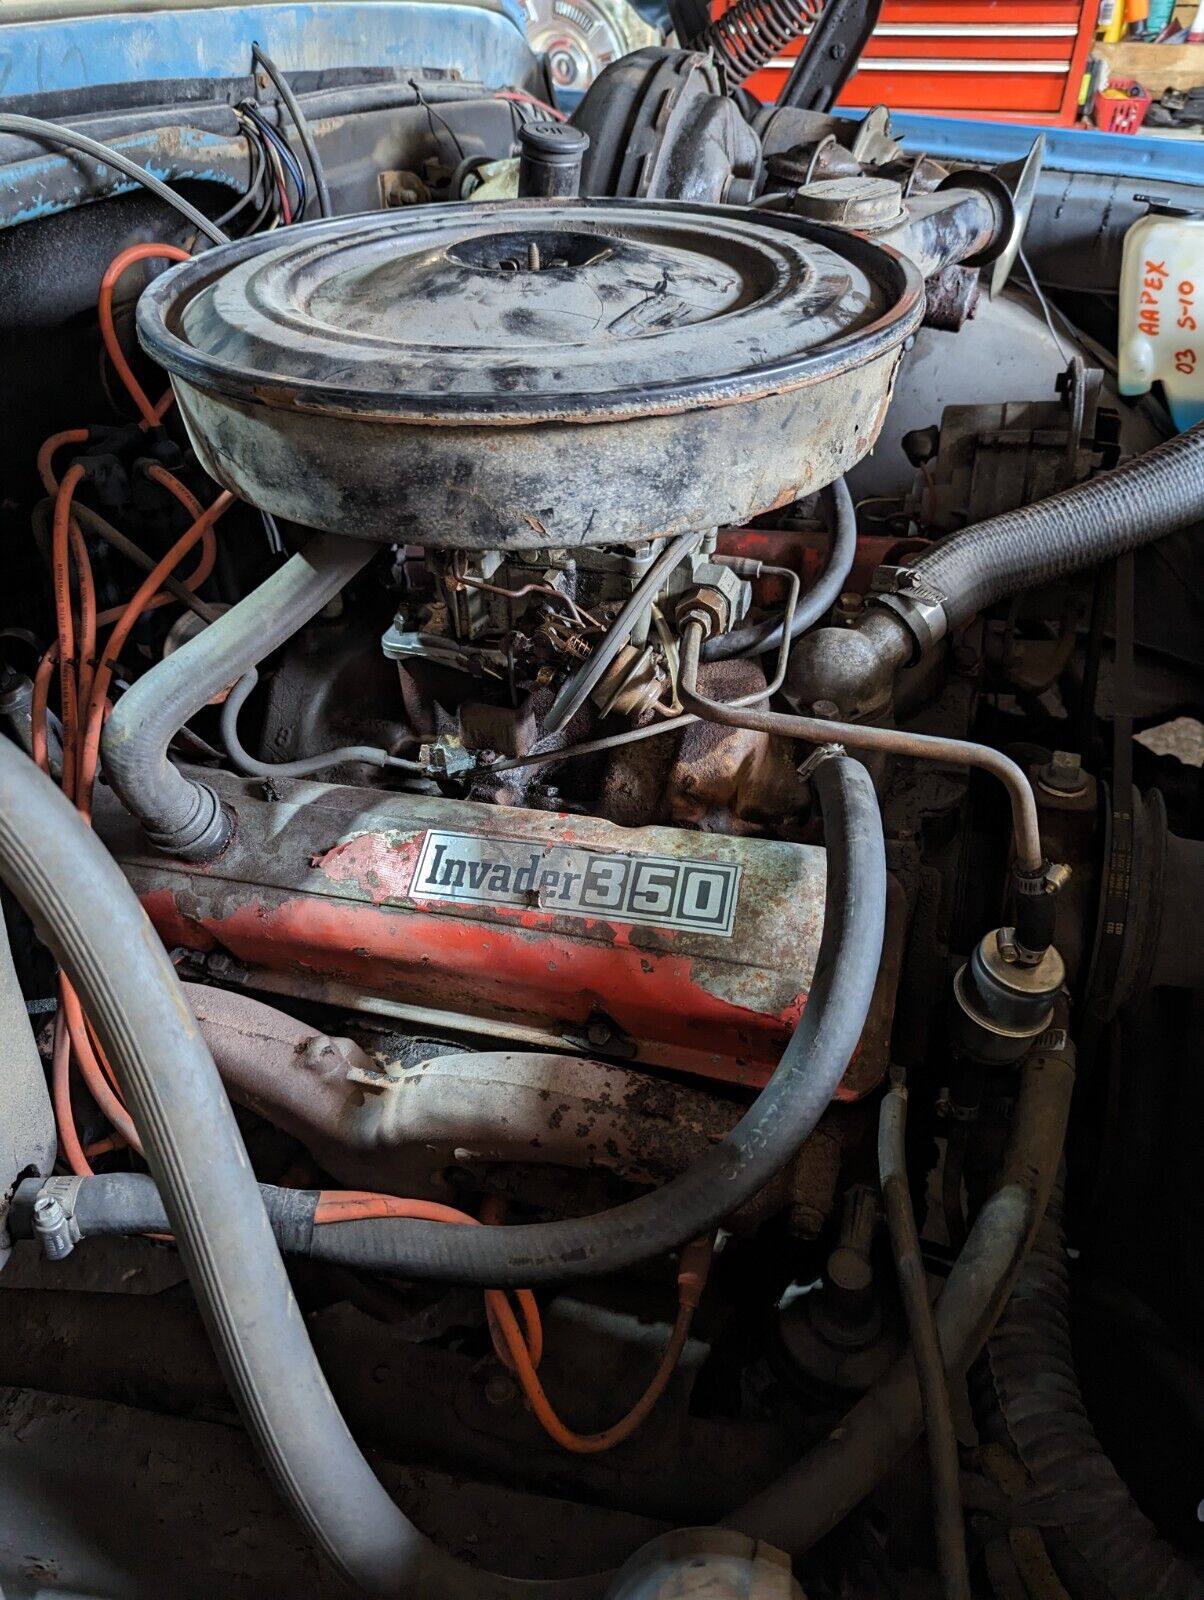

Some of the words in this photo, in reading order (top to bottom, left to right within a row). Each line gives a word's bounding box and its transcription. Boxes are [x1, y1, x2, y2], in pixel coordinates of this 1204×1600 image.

[1138, 260, 1169, 337] AAPEX
[1177, 280, 1197, 331] S-10
[1175, 349, 1197, 375] 03
[424, 844, 582, 901] Invader
[585, 857, 728, 920] 350
